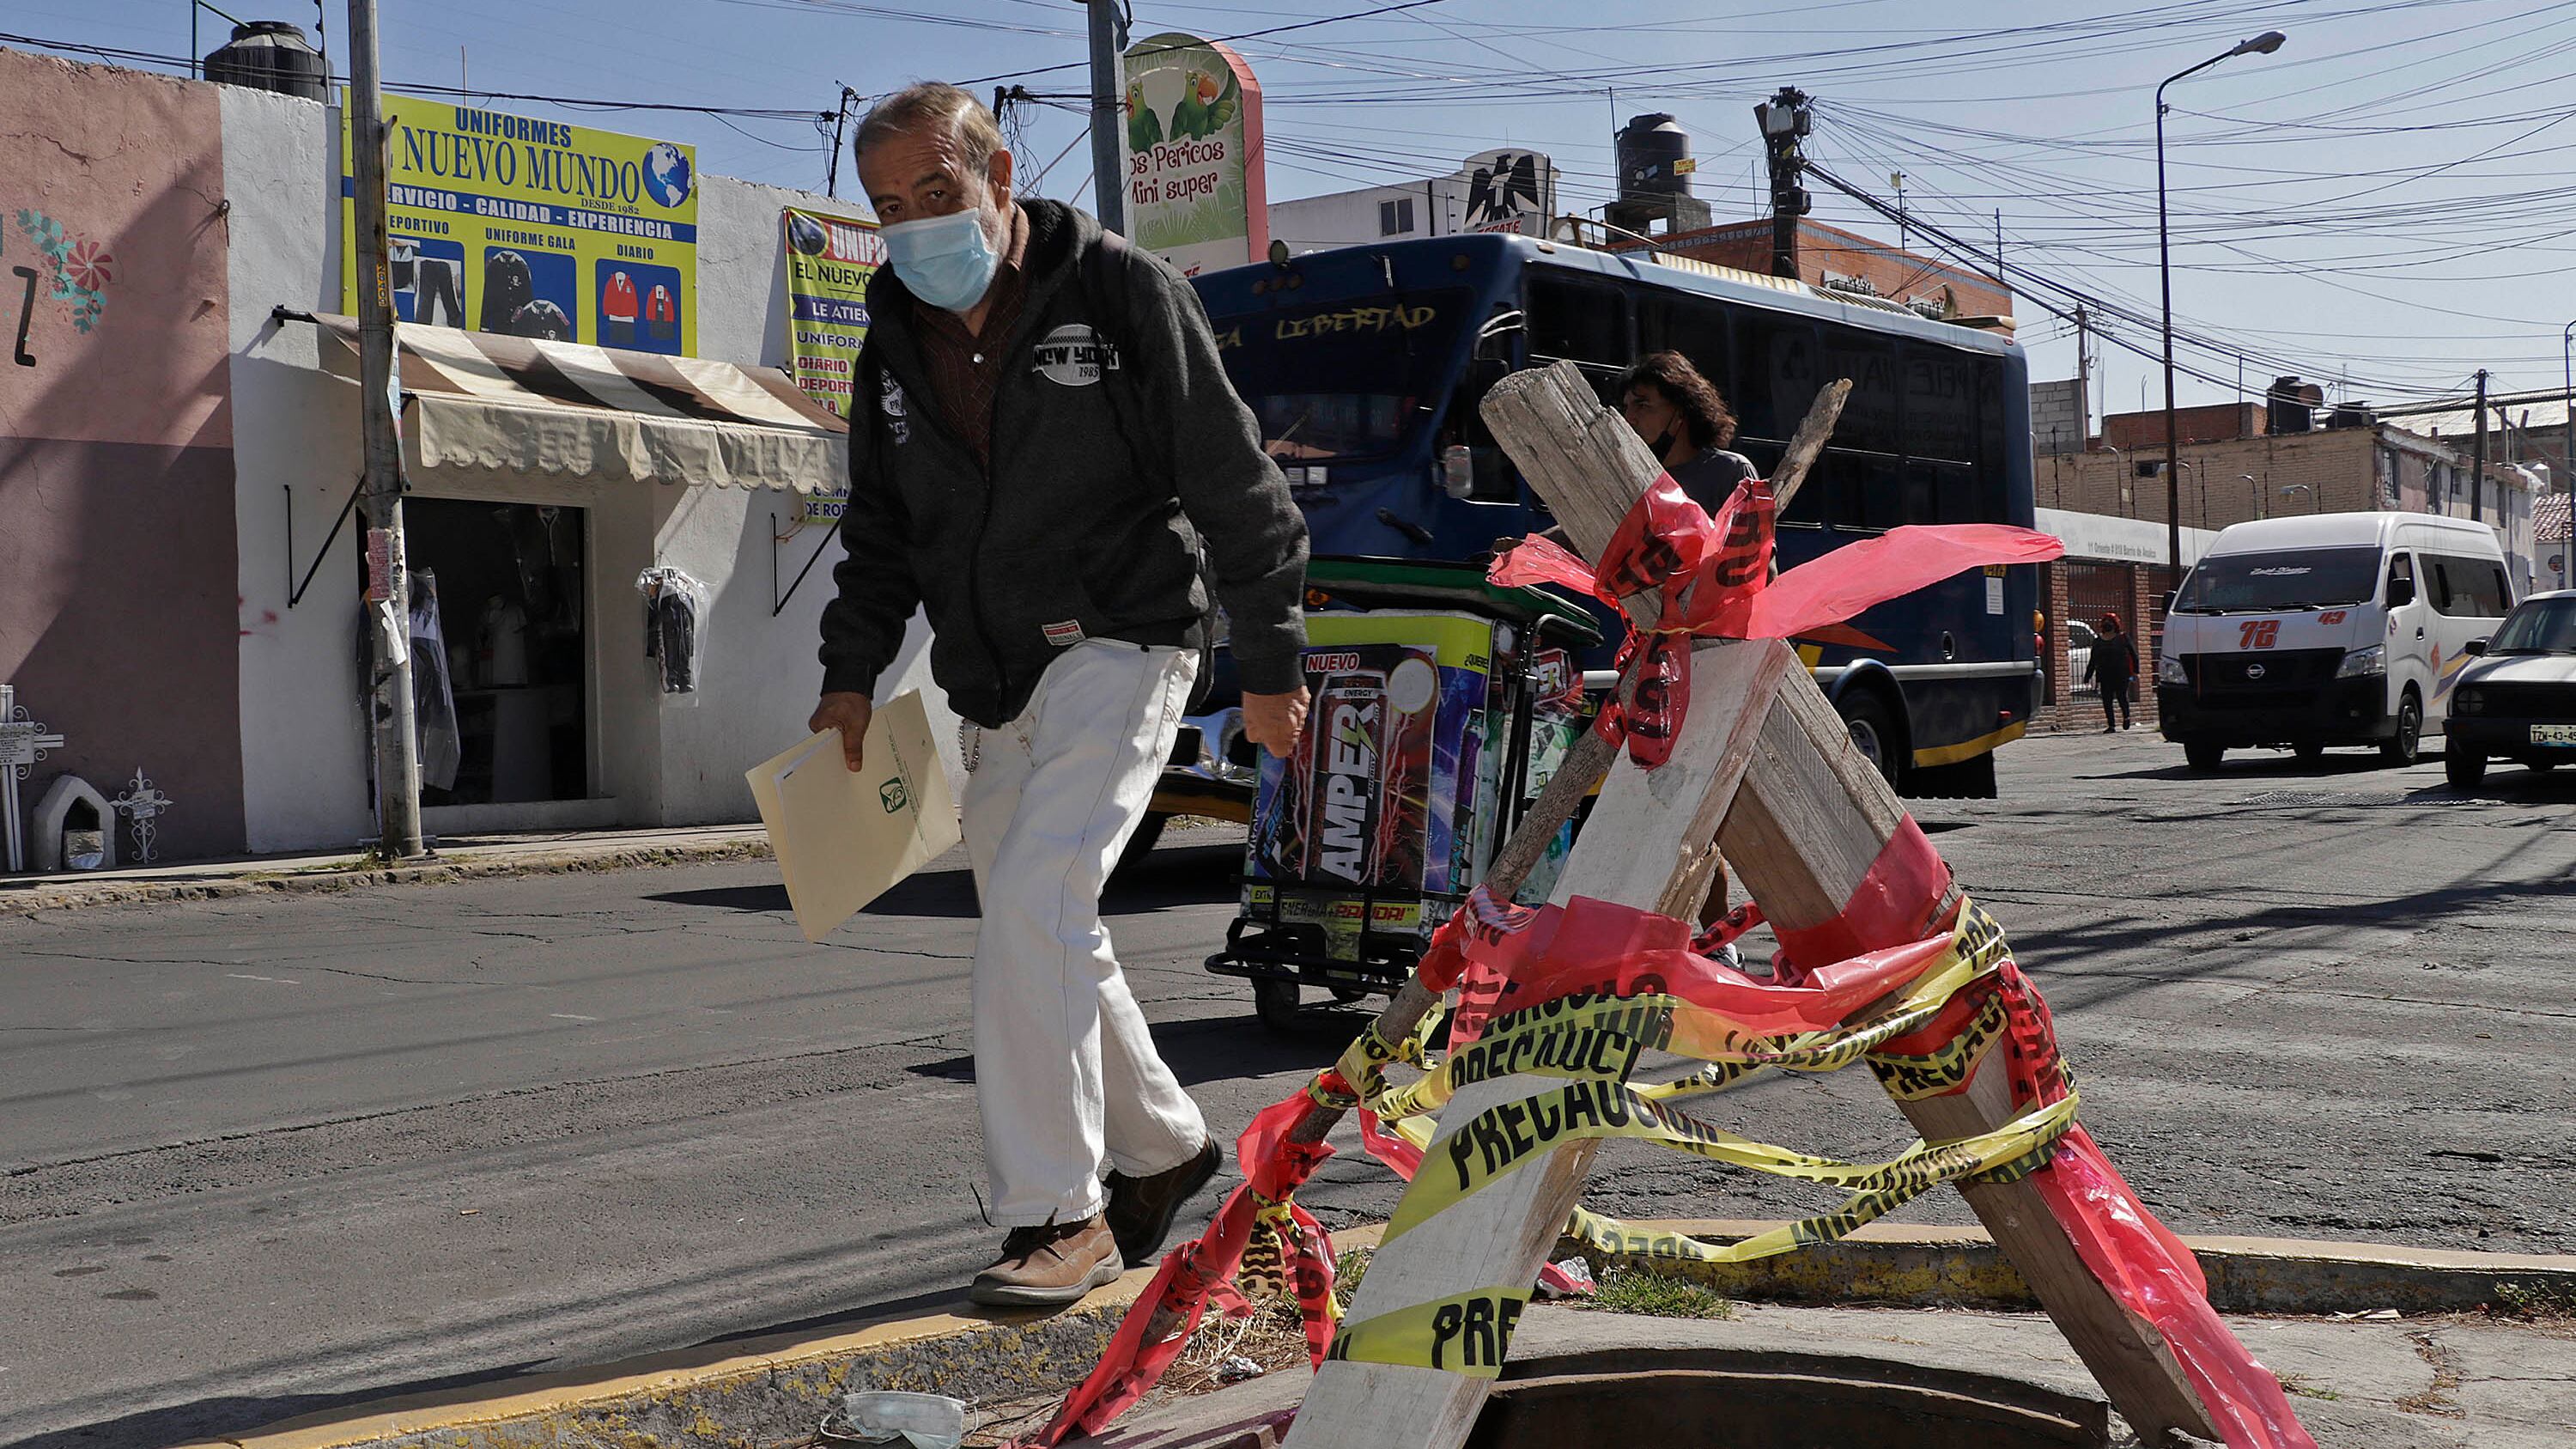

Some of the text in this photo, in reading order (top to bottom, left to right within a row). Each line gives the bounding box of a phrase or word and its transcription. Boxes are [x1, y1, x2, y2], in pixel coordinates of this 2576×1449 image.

[455, 107, 572, 148] UNIFORMES
[402, 125, 641, 204] NUEVO MUNDO
[1153, 141, 1224, 172] Pericos
[1166, 172, 1218, 202] super
[476, 198, 550, 224] CALIDAD
[568, 210, 673, 240] EXPERIENCIA
[580, 198, 641, 216] DESDE 1982
[485, 227, 576, 251] UNIFORME GALA
[617, 243, 654, 261] DIARIO
[795, 262, 871, 288] EL NUEVO
[812, 301, 829, 317] LE
[1276, 303, 1437, 340] LIBERTAD
[798, 356, 848, 373] DIARIO
[1033, 345, 1120, 368] NEW YOK
[1079, 366, 1099, 378] 1985
[2239, 619, 2281, 649] 72
[1307, 653, 1359, 673] NUEVO
[1343, 689, 1373, 697] ENERGY
[1320, 702, 1378, 885] AMPER
